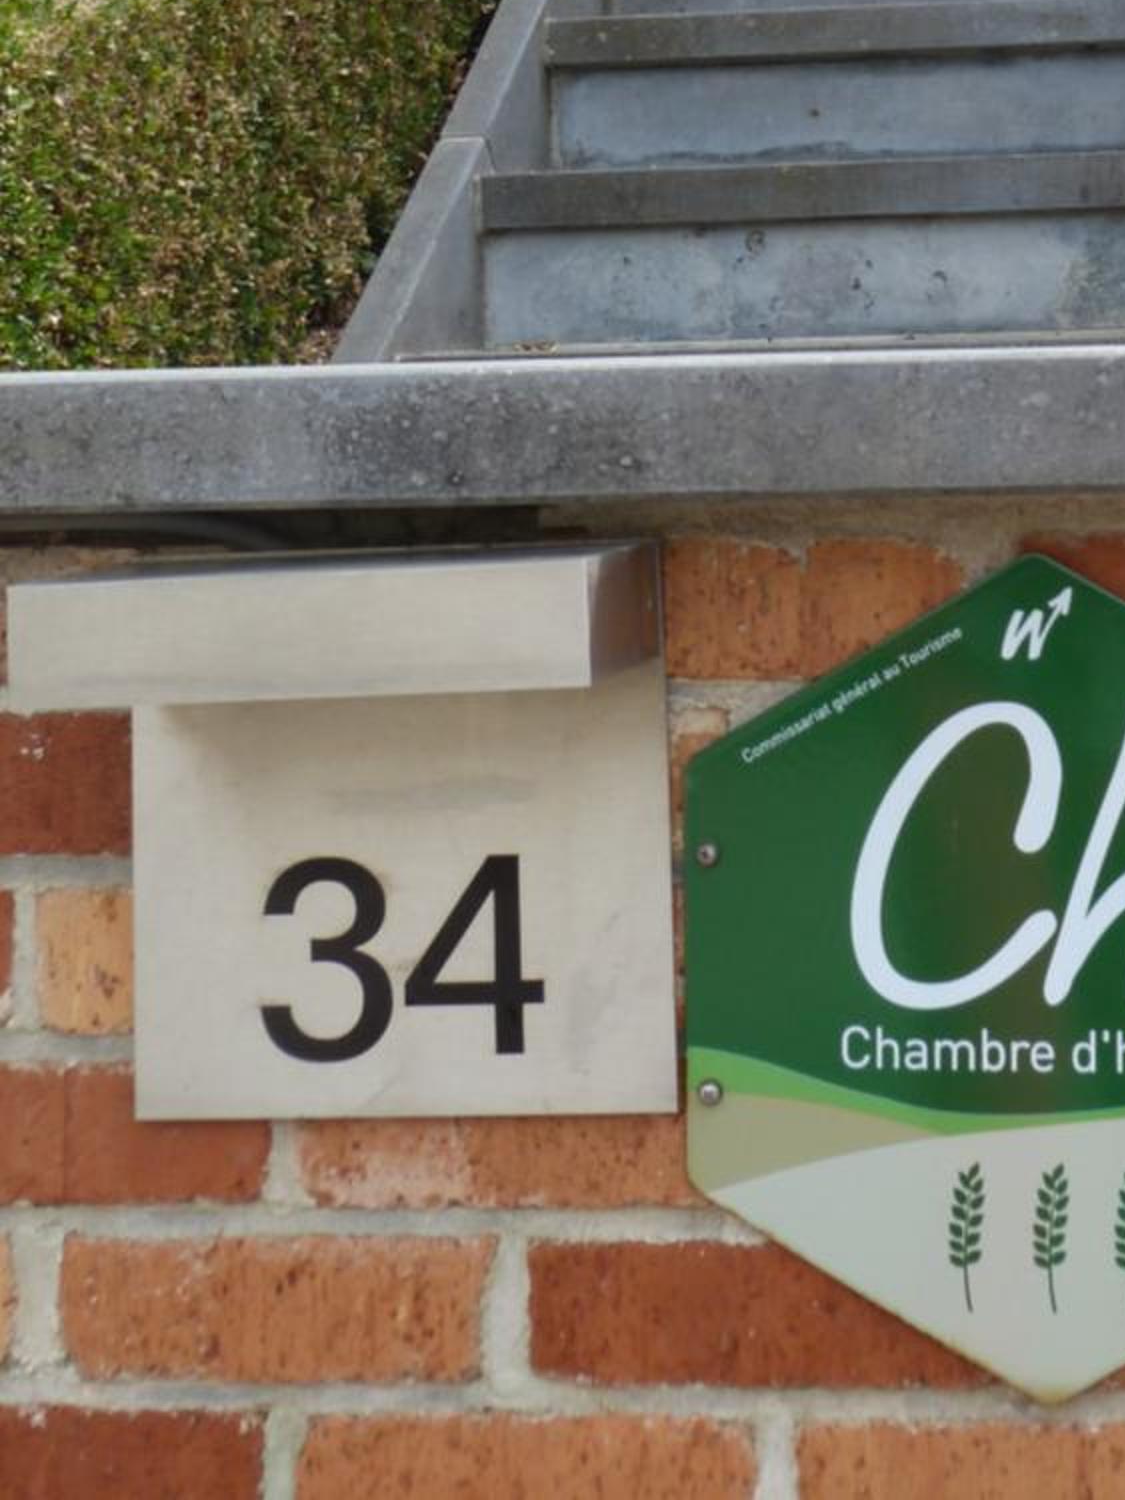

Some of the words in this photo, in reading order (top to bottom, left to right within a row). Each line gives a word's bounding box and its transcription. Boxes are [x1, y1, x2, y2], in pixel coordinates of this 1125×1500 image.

[742, 703, 832, 763] Commissariat
[832, 673, 882, 713] général
[883, 664, 901, 680] au
[899, 627, 963, 668] Tourisme
[262, 853, 545, 1063] 34
[840, 1025, 1056, 1074] Chambre
